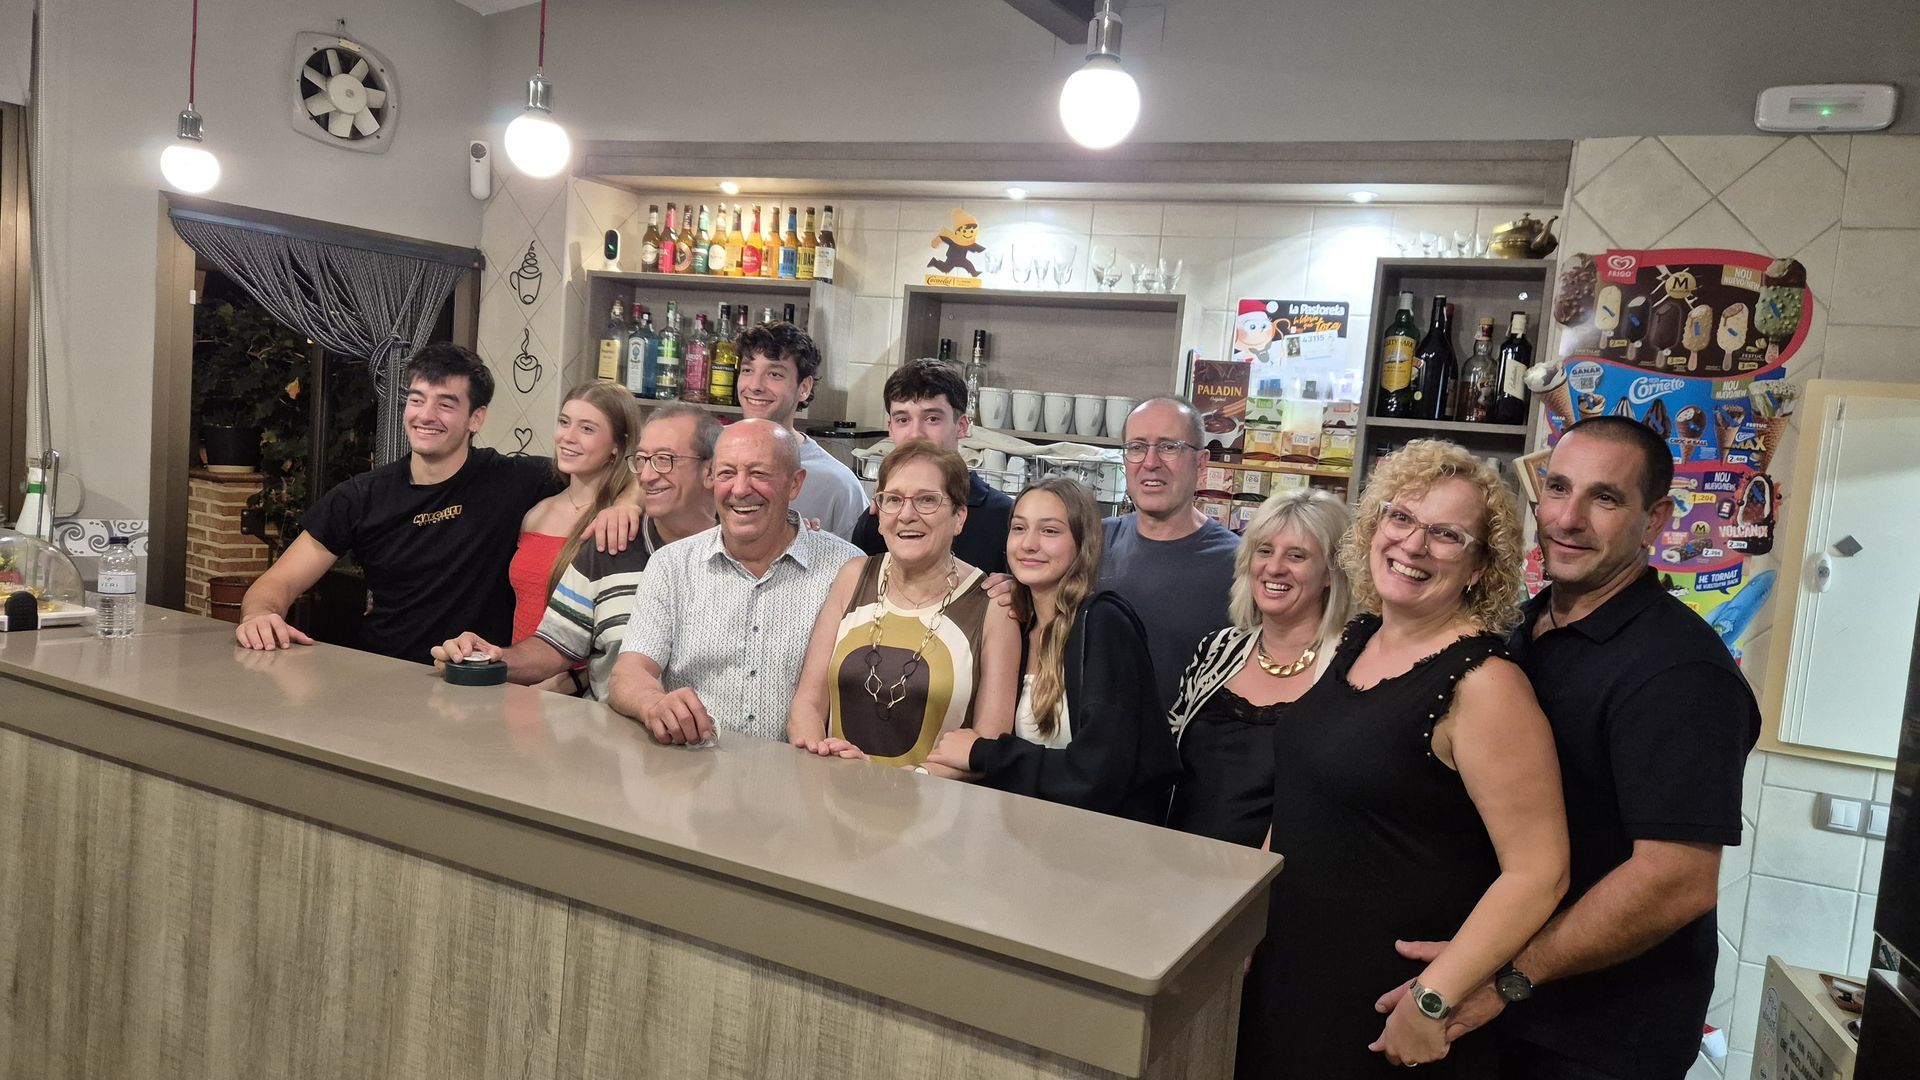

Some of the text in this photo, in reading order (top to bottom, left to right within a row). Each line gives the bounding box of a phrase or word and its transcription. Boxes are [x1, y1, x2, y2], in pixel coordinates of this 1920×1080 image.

[1607, 270, 1632, 278] FRIGO
[1735, 267, 1753, 280] NOU
[1672, 277, 1689, 290] M
[1300, 304, 1345, 315] Pastoreta
[1572, 367, 1601, 375] GANAR
[1197, 384, 1242, 396] PALADIN
[1629, 376, 1686, 404] Cornetto
[1722, 380, 1740, 391] NOU
[1732, 434, 1767, 451] MAX
[1714, 472, 1731, 482] NOU
[1718, 524, 1769, 538] VOLCANIX
[1698, 569, 1739, 584] HE TORNAT
